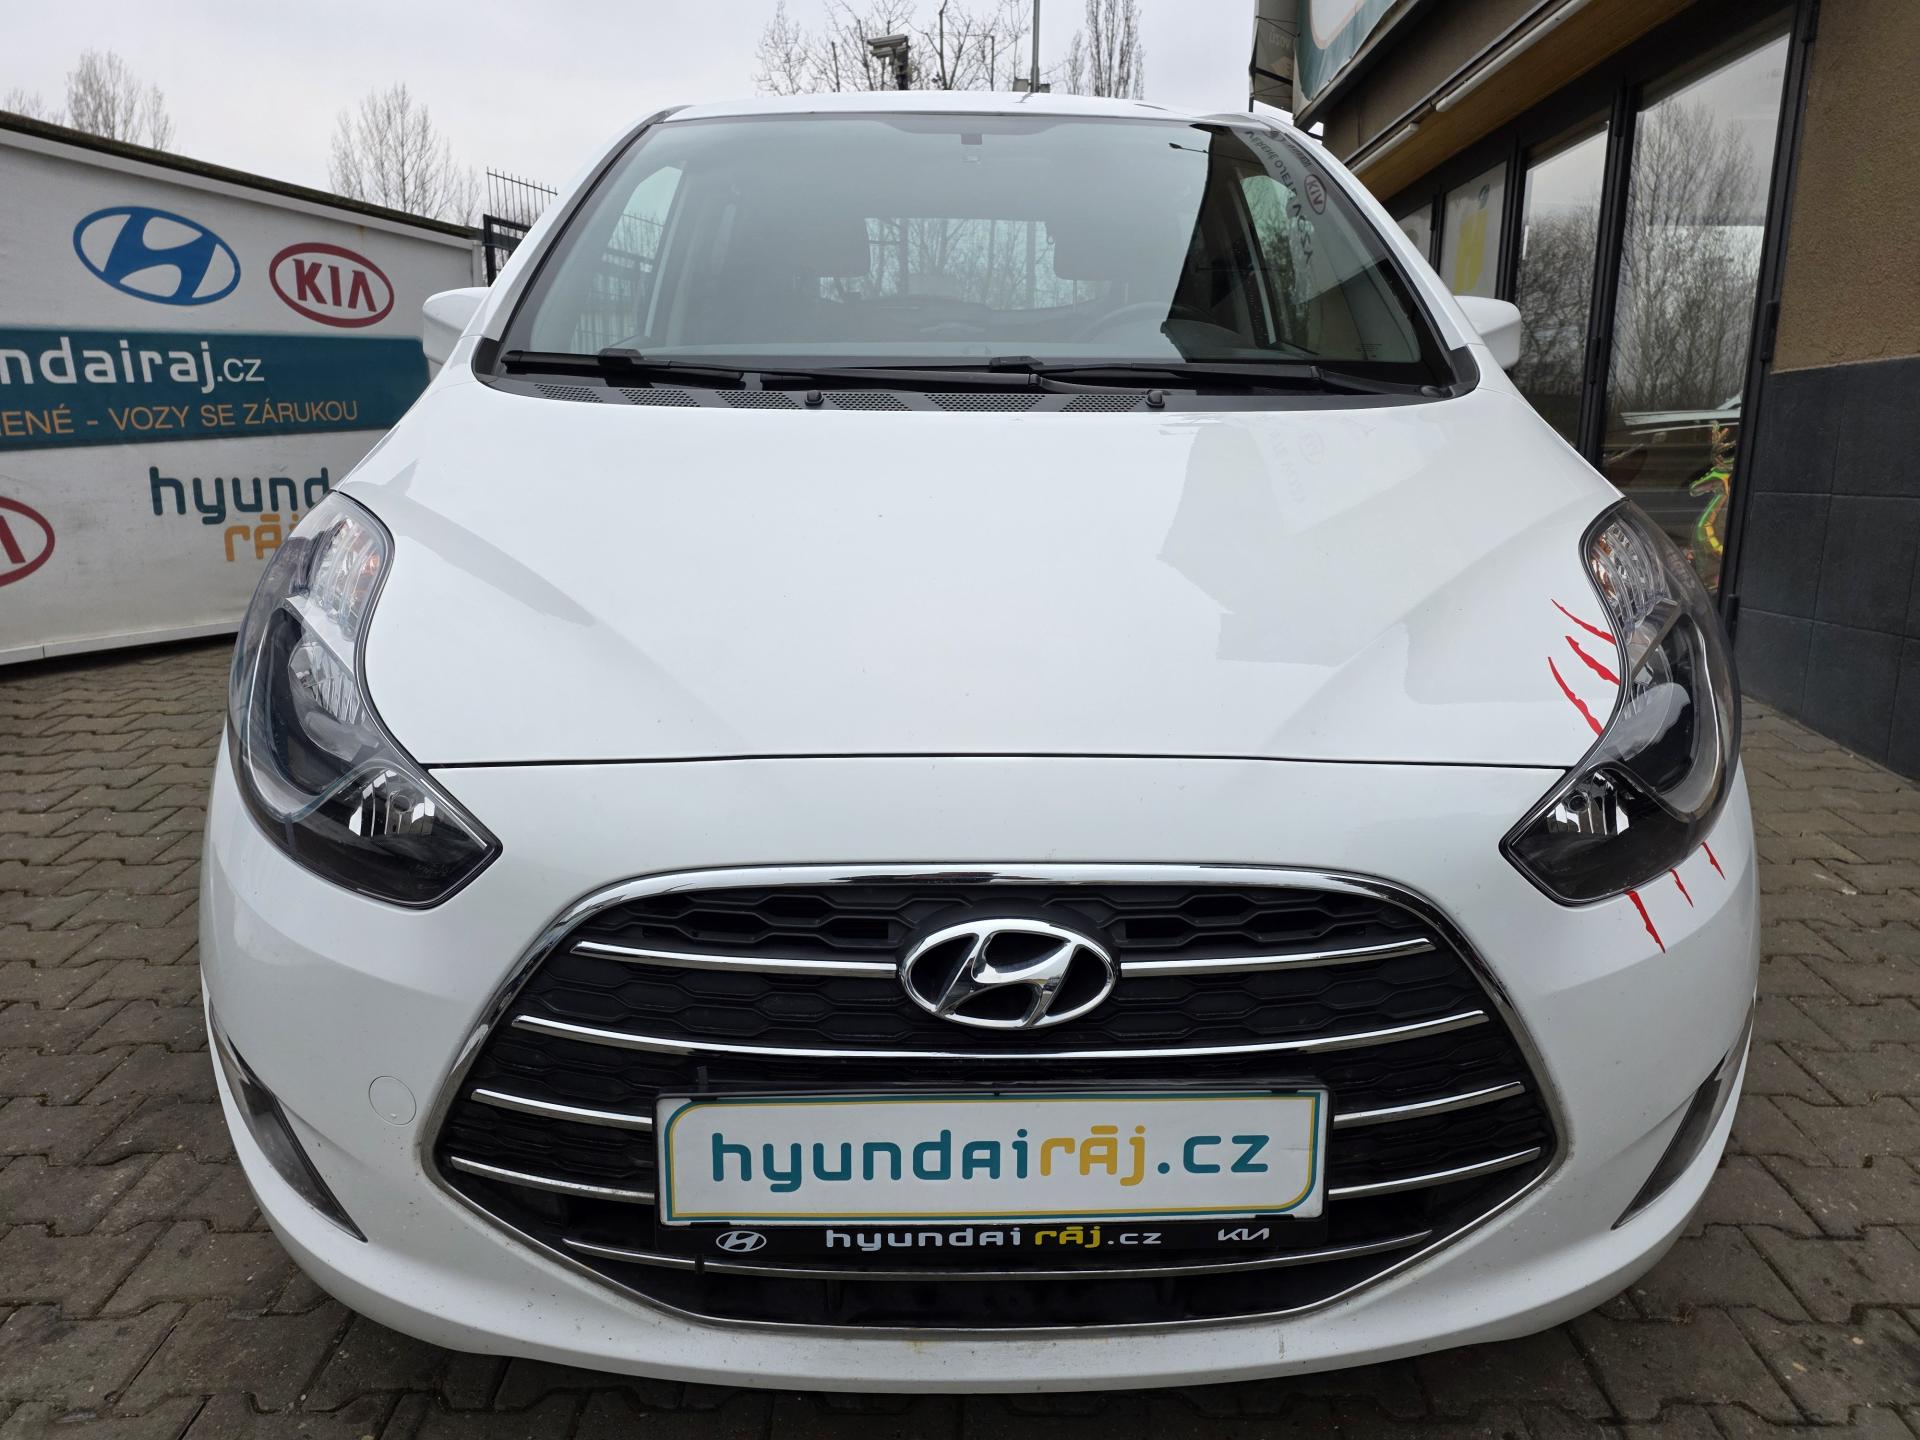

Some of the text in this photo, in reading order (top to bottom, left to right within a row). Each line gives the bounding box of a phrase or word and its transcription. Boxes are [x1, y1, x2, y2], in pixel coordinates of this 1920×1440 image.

[292, 258, 377, 312] KIA
[0, 403, 74, 437] ENÉ
[108, 406, 189, 431] VOZY
[201, 404, 235, 428] SE
[243, 398, 358, 425] ZÁRUKOU
